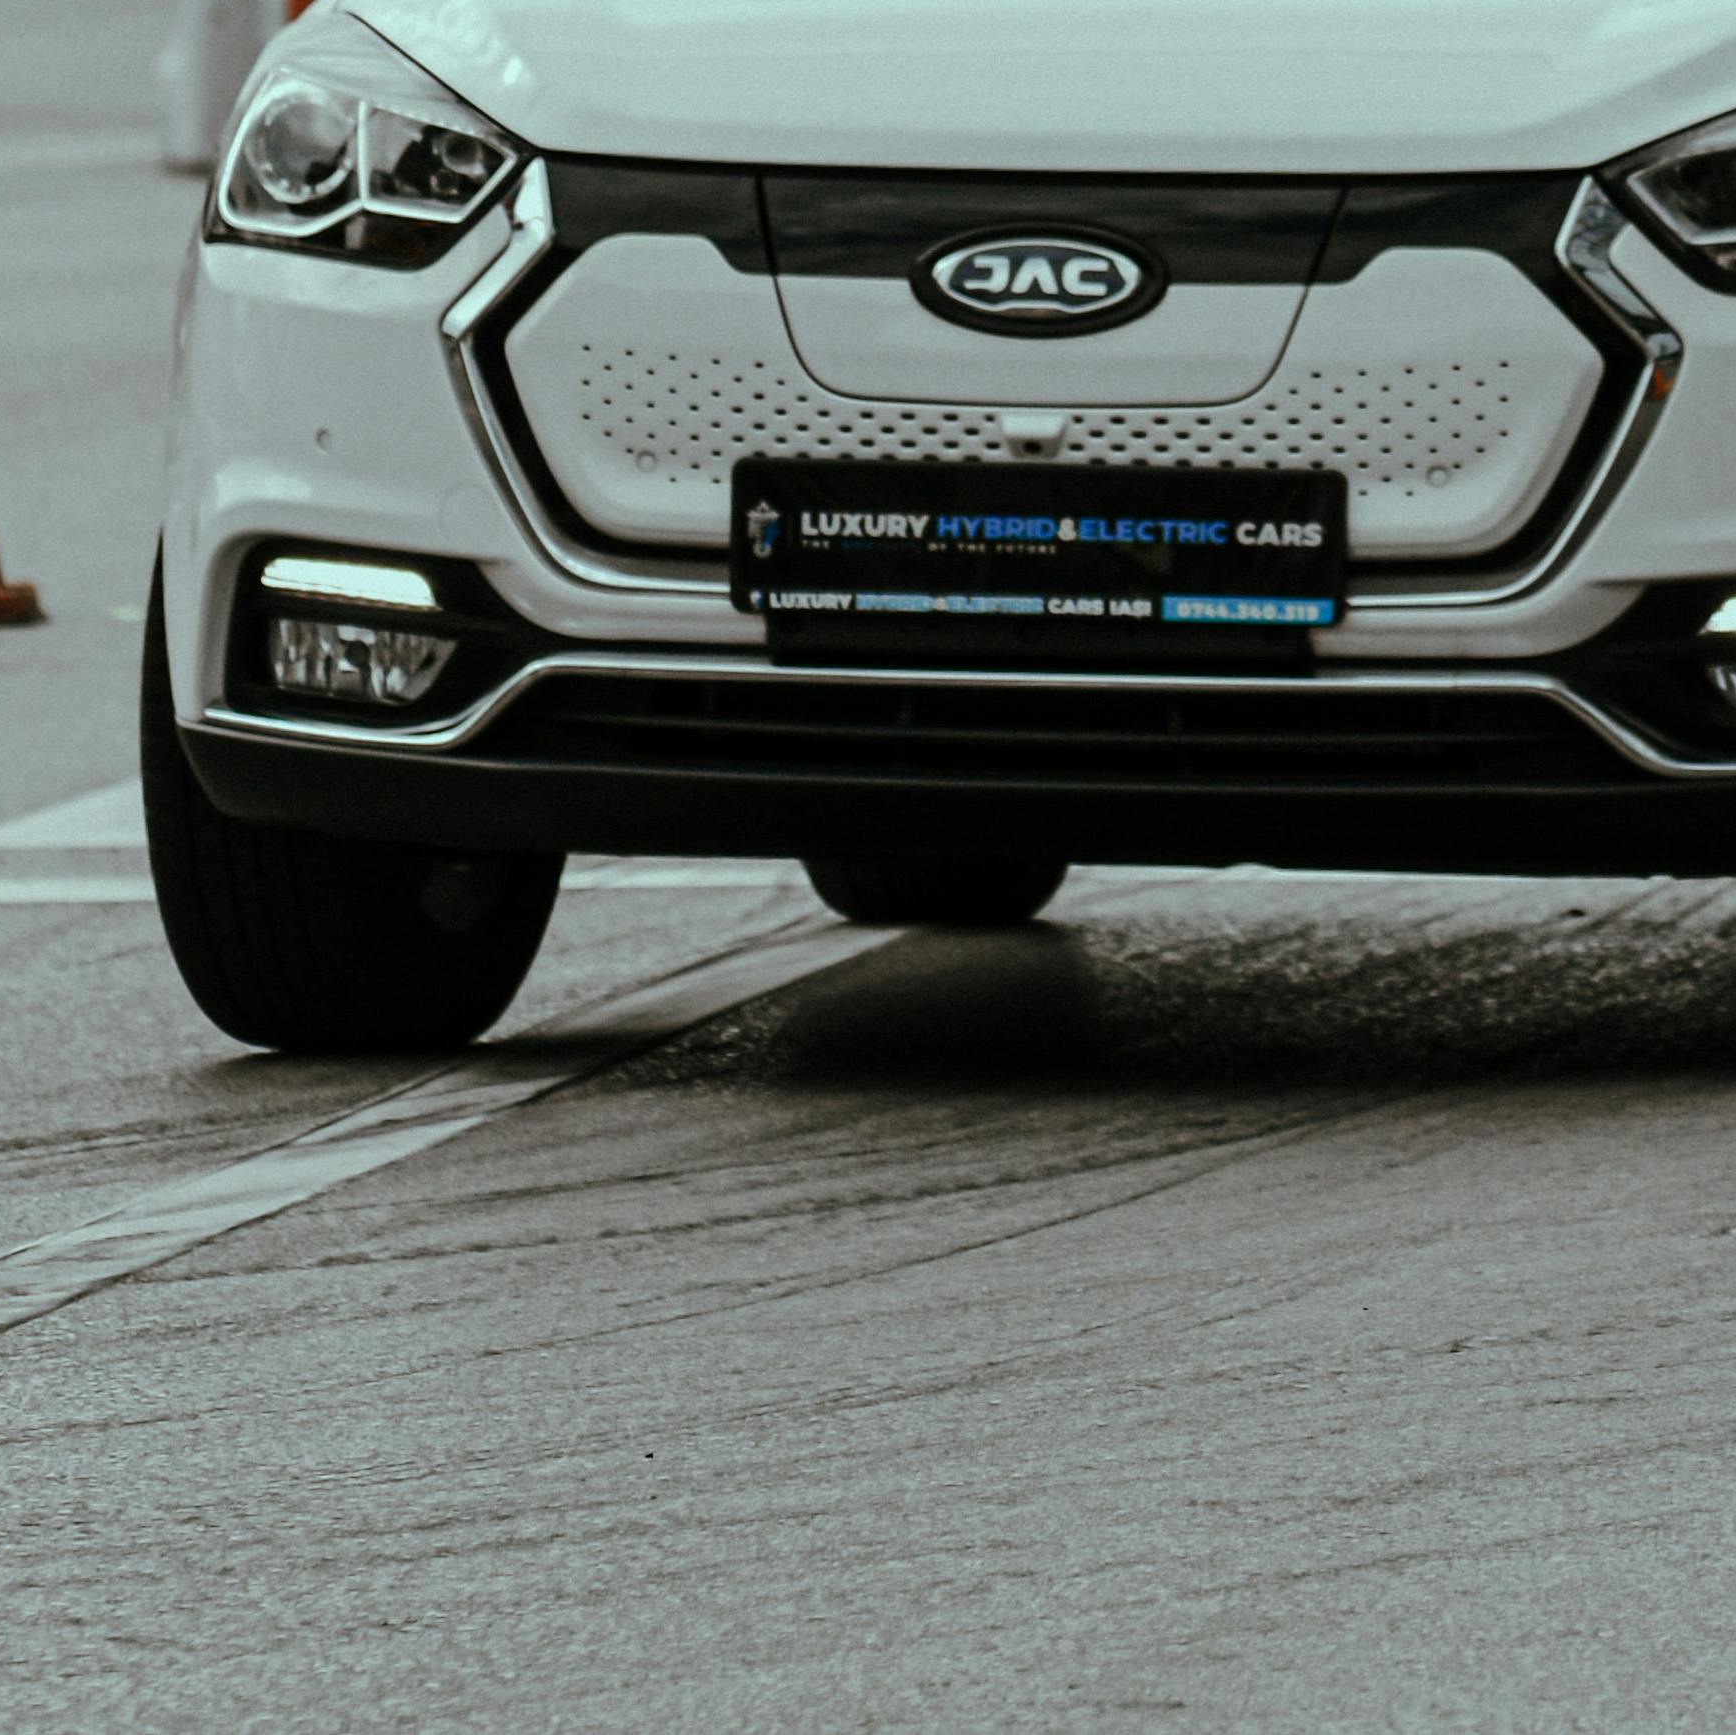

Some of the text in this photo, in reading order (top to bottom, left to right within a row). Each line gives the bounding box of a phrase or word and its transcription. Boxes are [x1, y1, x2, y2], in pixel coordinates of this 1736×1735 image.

[963, 254, 1110, 297] JAC
[801, 512, 1324, 548] LUXURY HYBRID&ELECTRIC CARS
[768, 592, 853, 611] LUXURY
[1047, 597, 1105, 616] CARS
